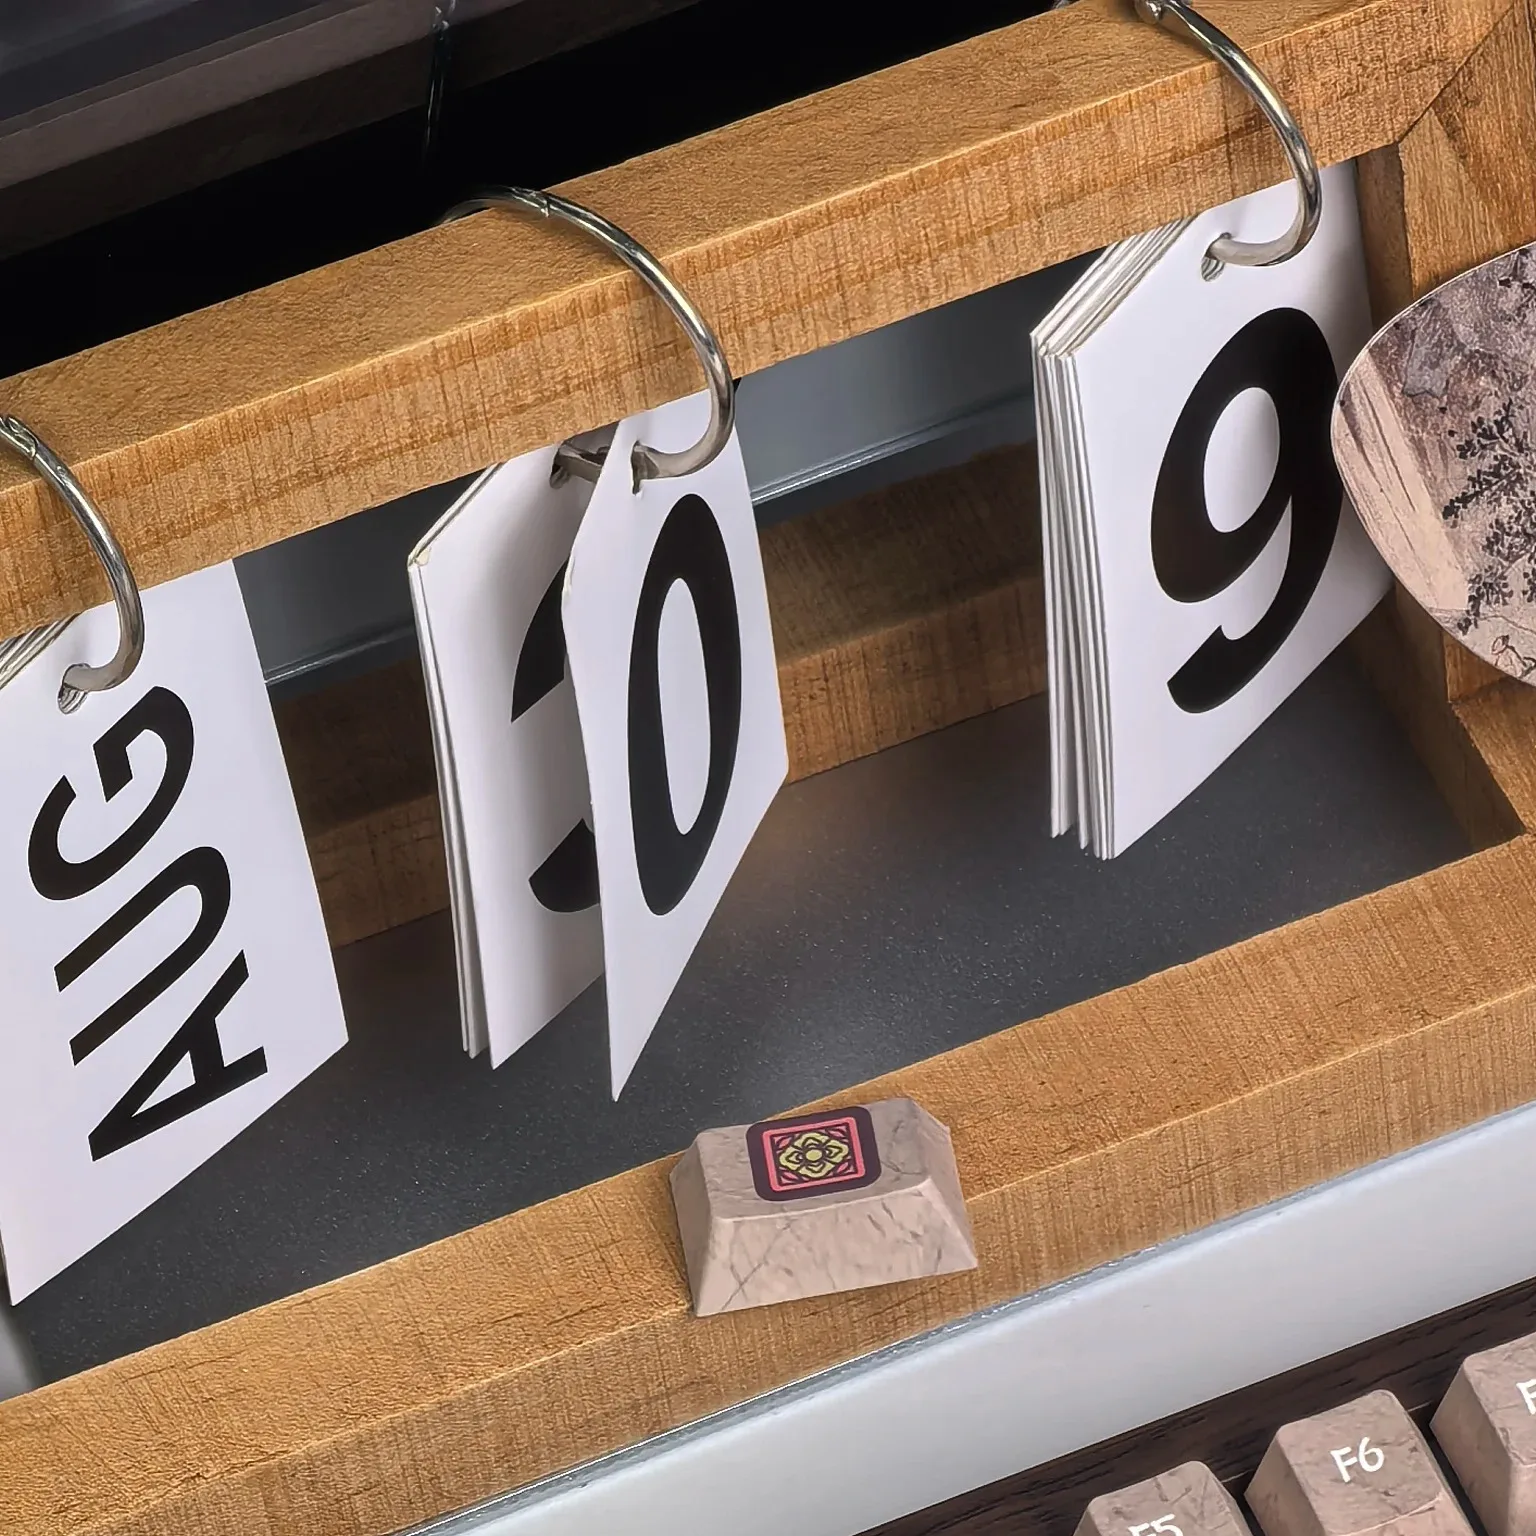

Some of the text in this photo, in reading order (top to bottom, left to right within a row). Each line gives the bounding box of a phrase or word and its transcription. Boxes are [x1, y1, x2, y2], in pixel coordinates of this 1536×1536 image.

[627, 493, 743, 916] 0
[1150, 306, 1343, 714] 9
[27, 685, 269, 1162] AUG
[1330, 1436, 1385, 1483] F6
